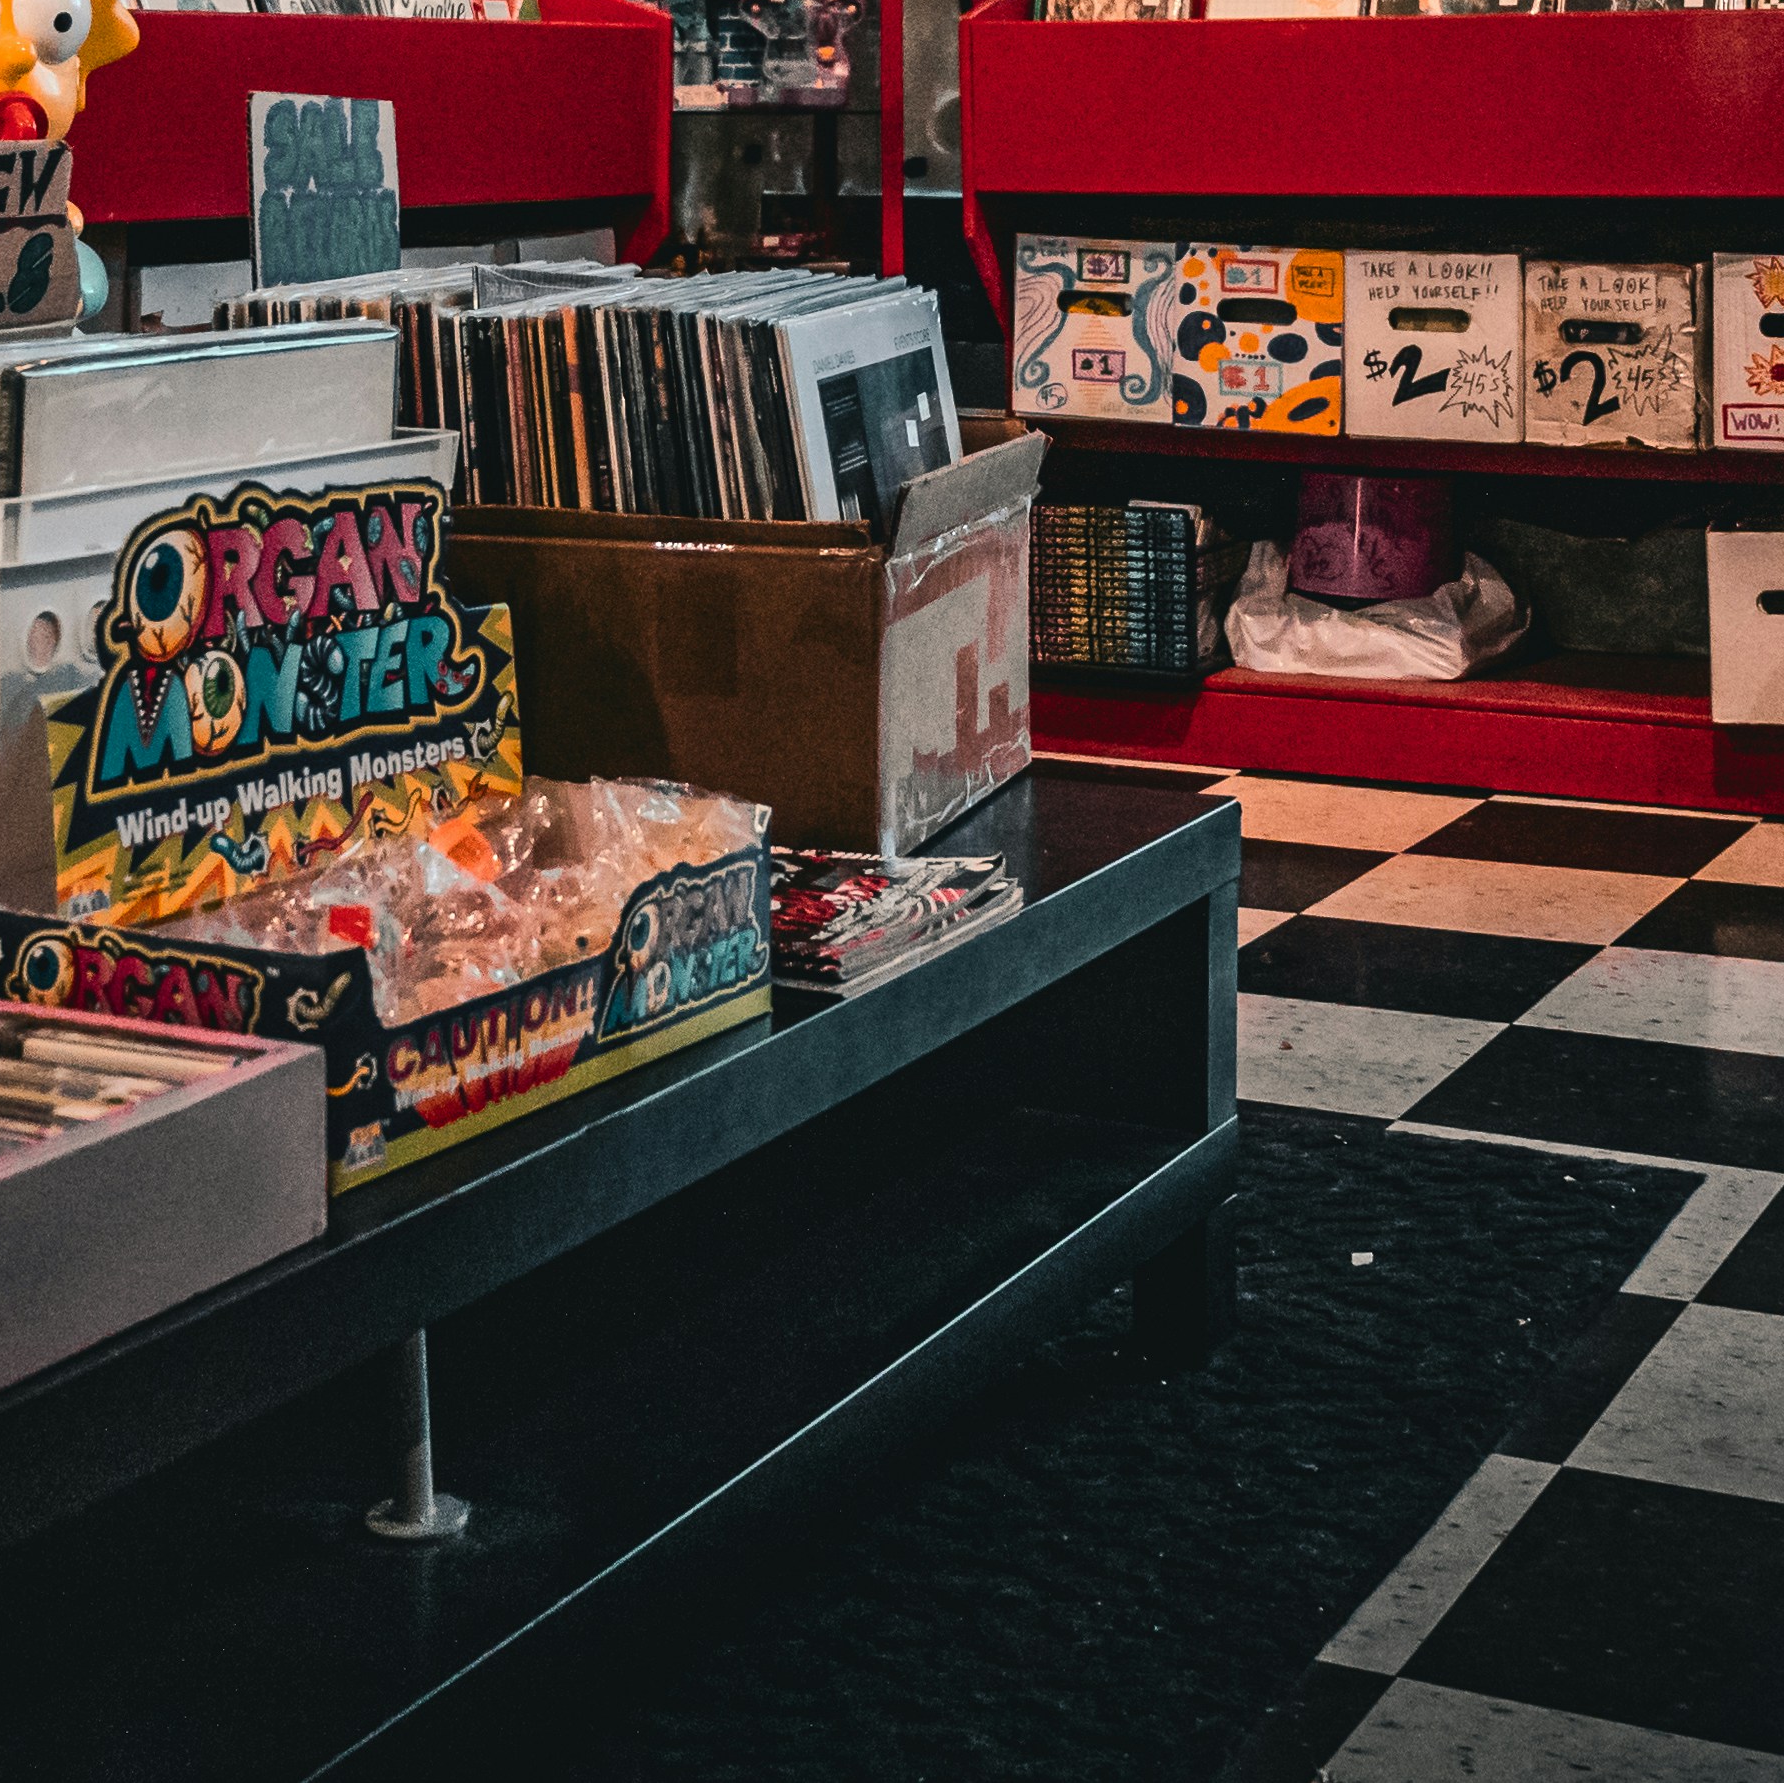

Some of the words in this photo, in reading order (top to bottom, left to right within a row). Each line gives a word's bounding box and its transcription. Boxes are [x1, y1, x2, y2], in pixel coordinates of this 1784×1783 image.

[1361, 262, 1395, 278] TAKE
[1408, 260, 1418, 277] A
[1368, 284, 1400, 301] HELP
[1538, 276, 1568, 293] TAKE
[1579, 276, 1589, 290] A
[1540, 296, 1567, 311] HELP
[1730, 412, 1780, 433] WOW!
[129, 501, 432, 662] ORGAN
[117, 798, 231, 850] Wind-up
[237, 766, 344, 817] Walking
[350, 734, 467, 784] Monsters
